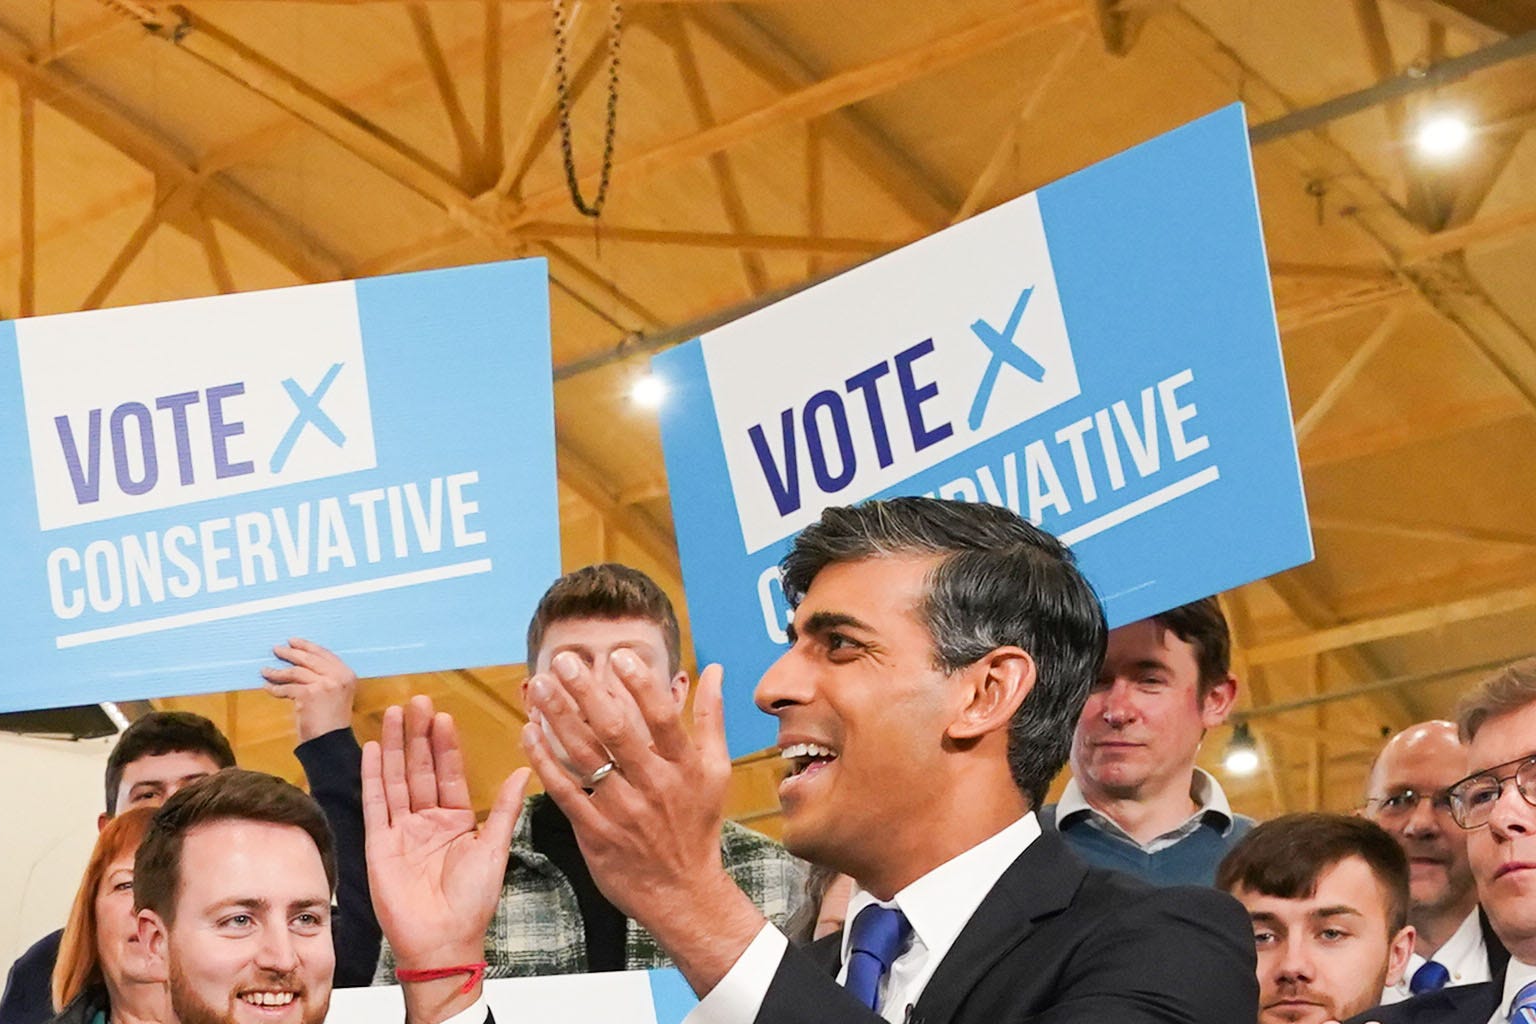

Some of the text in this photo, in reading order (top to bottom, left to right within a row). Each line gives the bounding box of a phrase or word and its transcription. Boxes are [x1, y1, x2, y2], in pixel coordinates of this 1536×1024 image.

[54, 381, 255, 505] VOTE
[747, 338, 954, 518] VOTE
[757, 368, 1211, 645] CVATIVE
[46, 471, 487, 620] CONSERVATIVE
